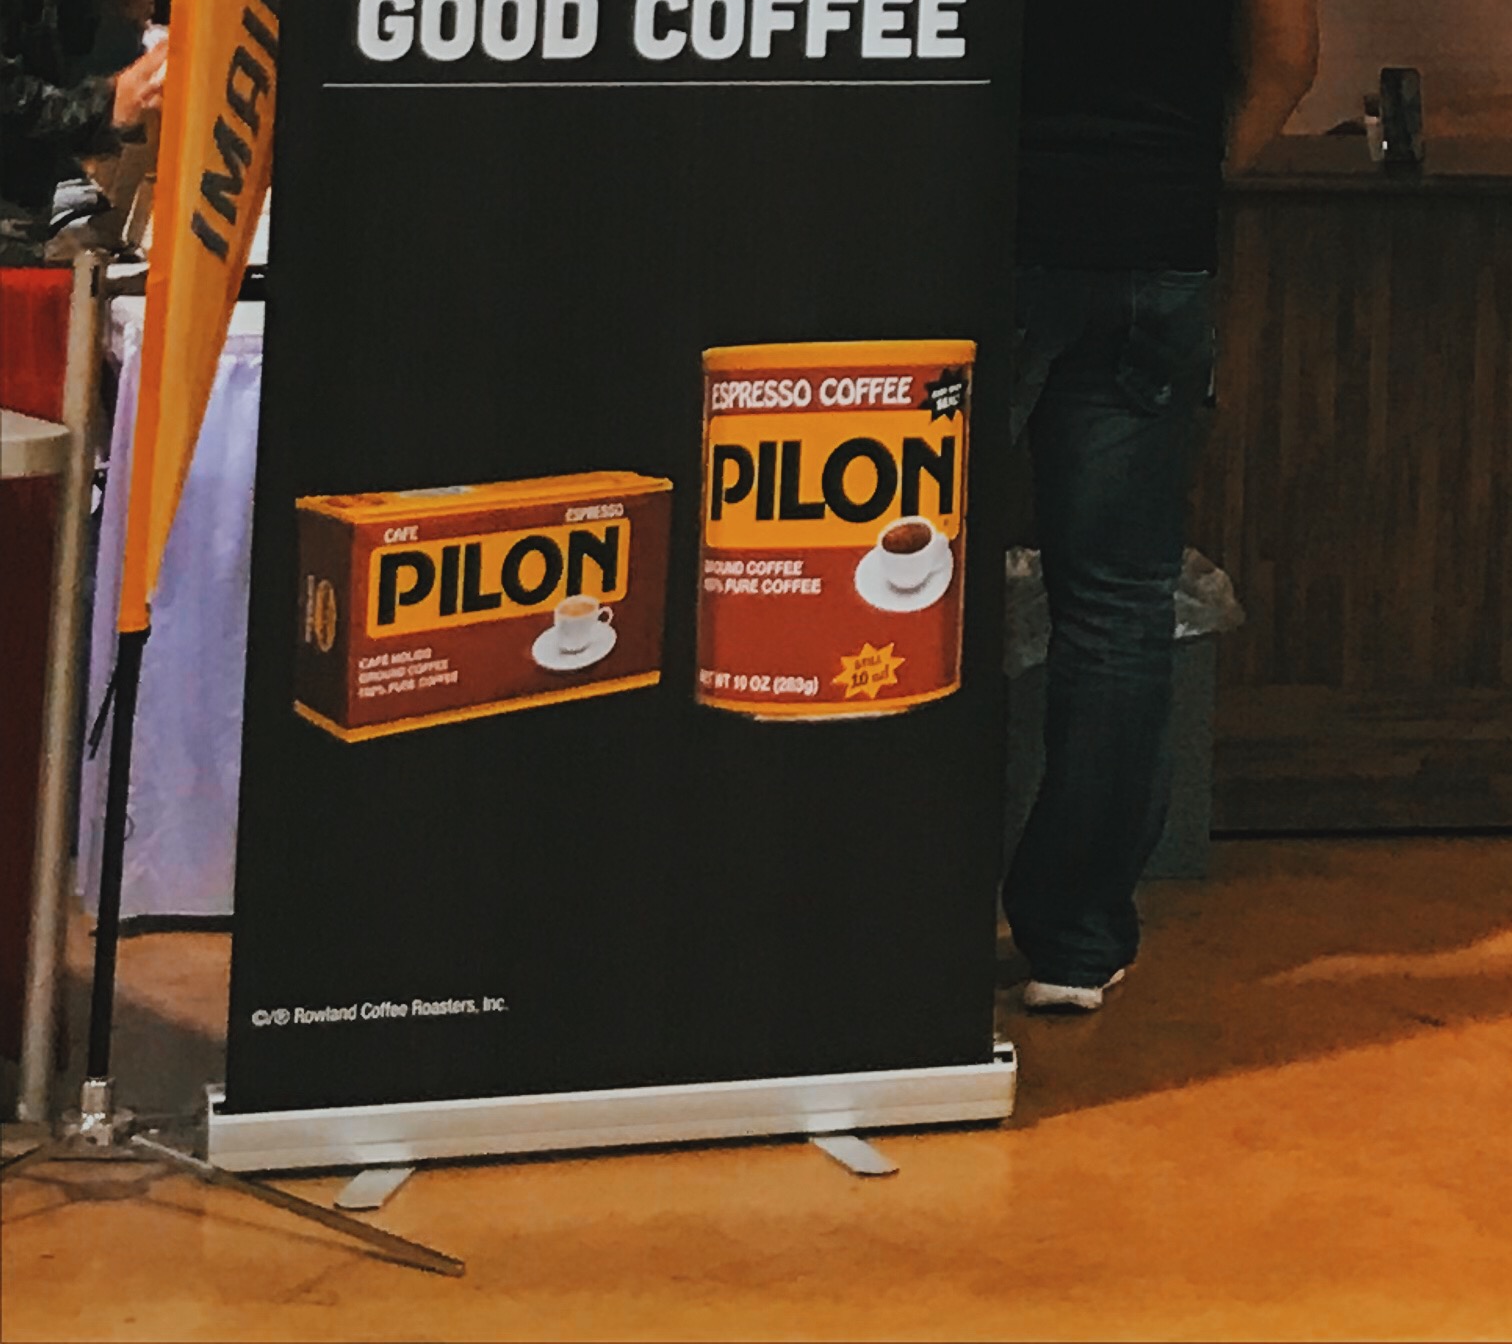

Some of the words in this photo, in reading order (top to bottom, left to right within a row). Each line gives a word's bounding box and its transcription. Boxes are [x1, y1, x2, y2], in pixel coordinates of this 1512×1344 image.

[711, 379, 812, 411] ESPRESSO
[820, 375, 914, 407] COFFEE
[711, 435, 956, 524] PILON
[377, 525, 620, 627] PILON
[746, 559, 804, 577] COFFEE
[724, 577, 759, 594] PURE
[761, 577, 821, 595] COFFEE
[749, 674, 771, 692] OZ
[294, 1003, 358, 1024] Rowland
[360, 1000, 408, 1021] Coffee
